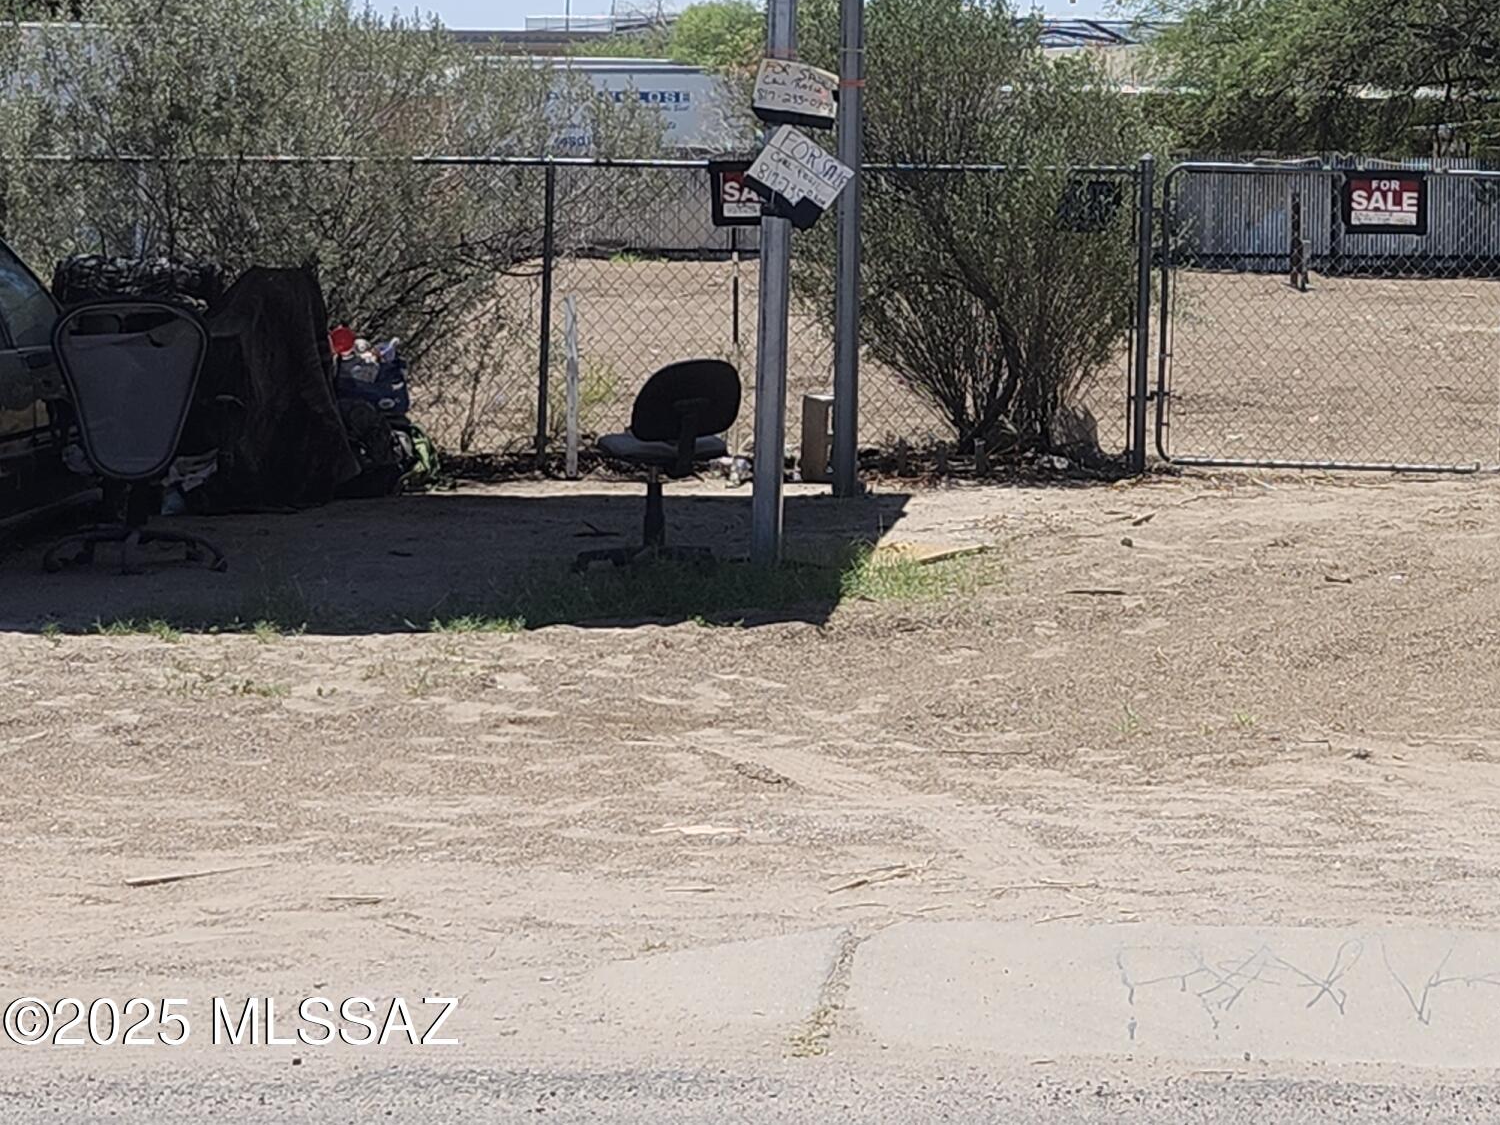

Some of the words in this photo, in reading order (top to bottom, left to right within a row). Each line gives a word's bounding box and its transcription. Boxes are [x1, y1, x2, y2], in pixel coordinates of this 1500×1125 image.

[780, 130, 823, 170] FOR
[723, 181, 760, 202] SA
[1371, 179, 1400, 191] FOR
[1351, 189, 1418, 212] SALE
